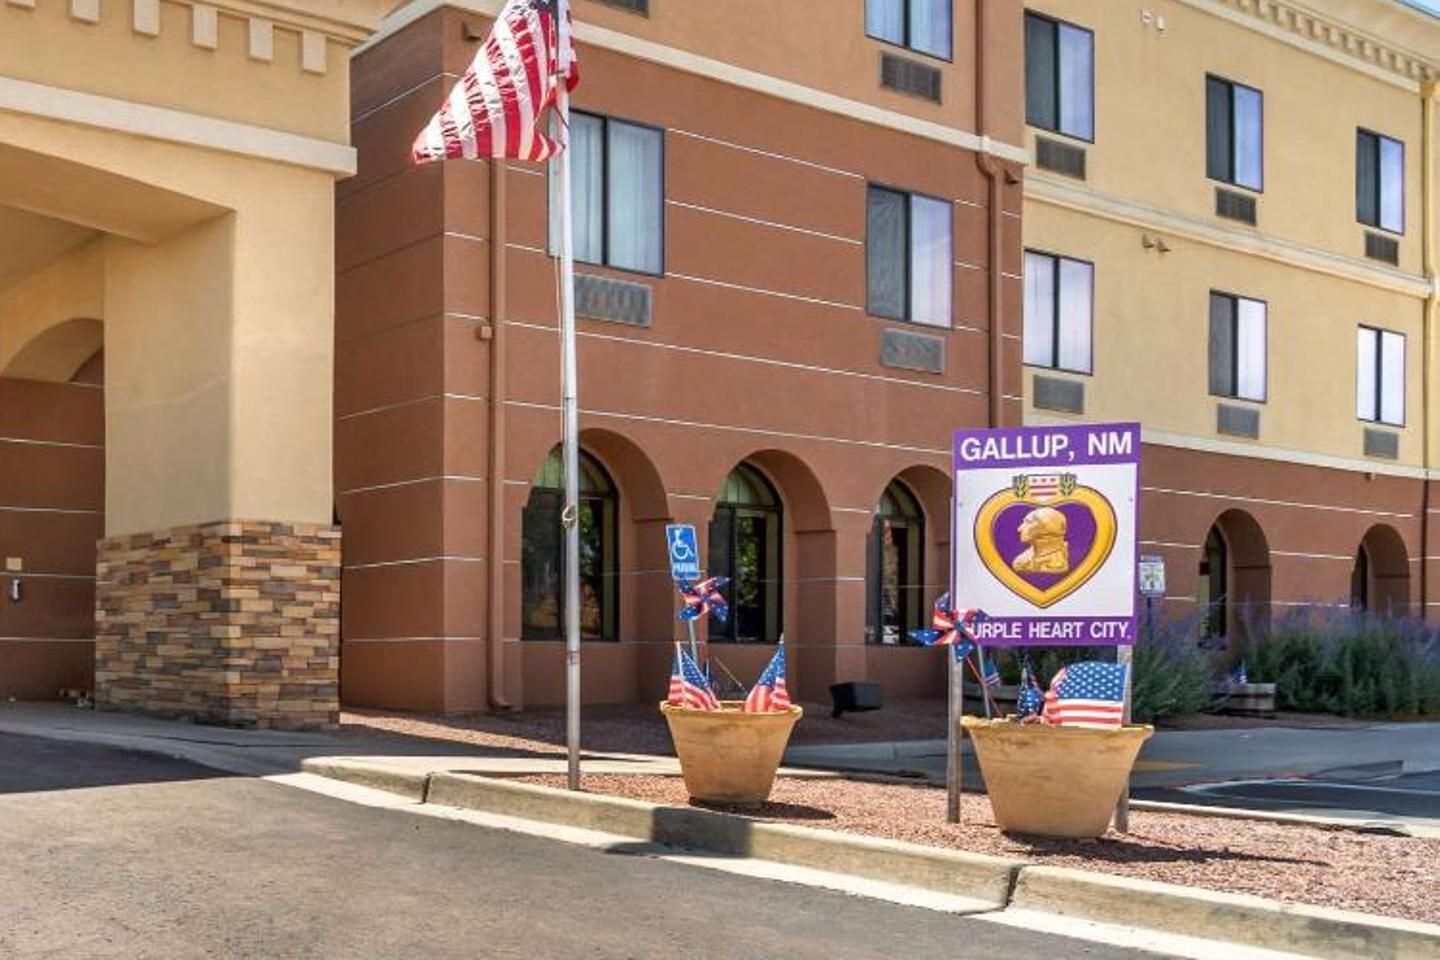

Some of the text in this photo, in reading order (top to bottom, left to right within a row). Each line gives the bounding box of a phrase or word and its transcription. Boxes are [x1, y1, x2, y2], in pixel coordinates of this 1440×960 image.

[961, 431, 1133, 462] GALLUP, NM
[971, 622, 1023, 639] URPLE
[1028, 621, 1085, 639] HEART
